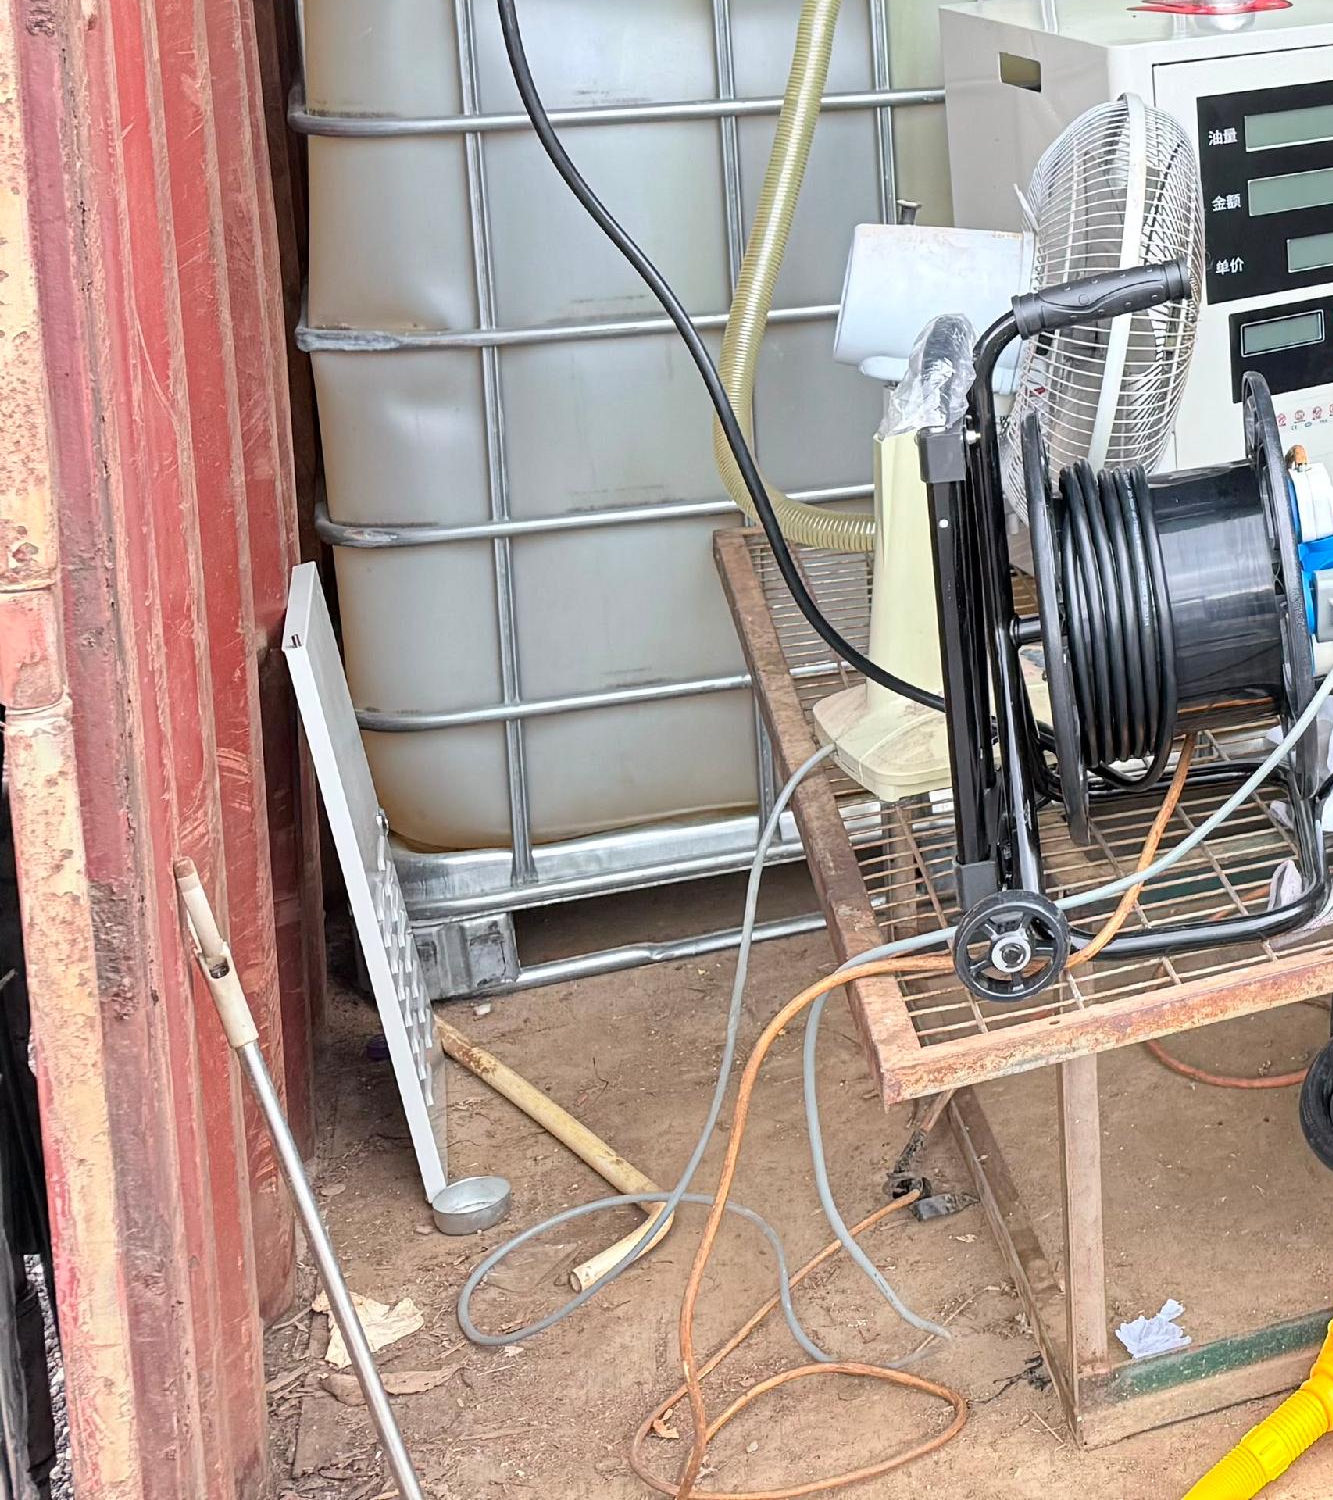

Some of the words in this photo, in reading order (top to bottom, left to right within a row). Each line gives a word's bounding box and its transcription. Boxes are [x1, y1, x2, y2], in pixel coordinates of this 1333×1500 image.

[1208, 127, 1238, 146] 油量
[1212, 193, 1242, 212] 金额
[1215, 257, 1245, 276] 单价
